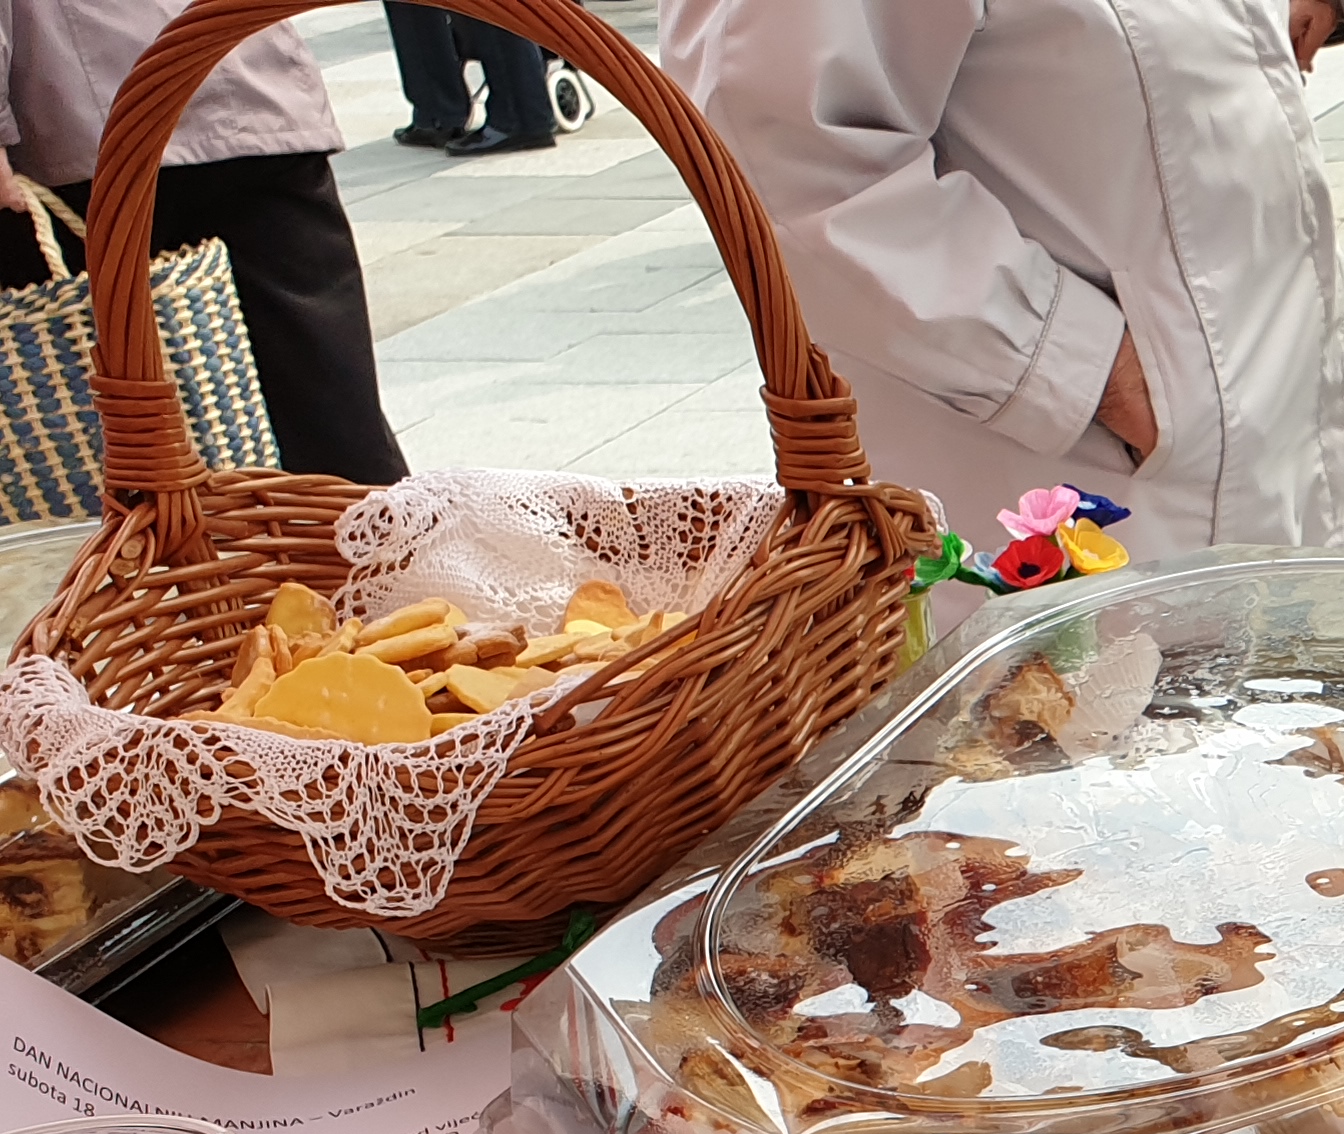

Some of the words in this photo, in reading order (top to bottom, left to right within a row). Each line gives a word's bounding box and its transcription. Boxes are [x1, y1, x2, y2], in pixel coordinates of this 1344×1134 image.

[8, 1062, 67, 1105] subota
[13, 1036, 52, 1069] DAN
[328, 1087, 417, 1118] Varaždin
